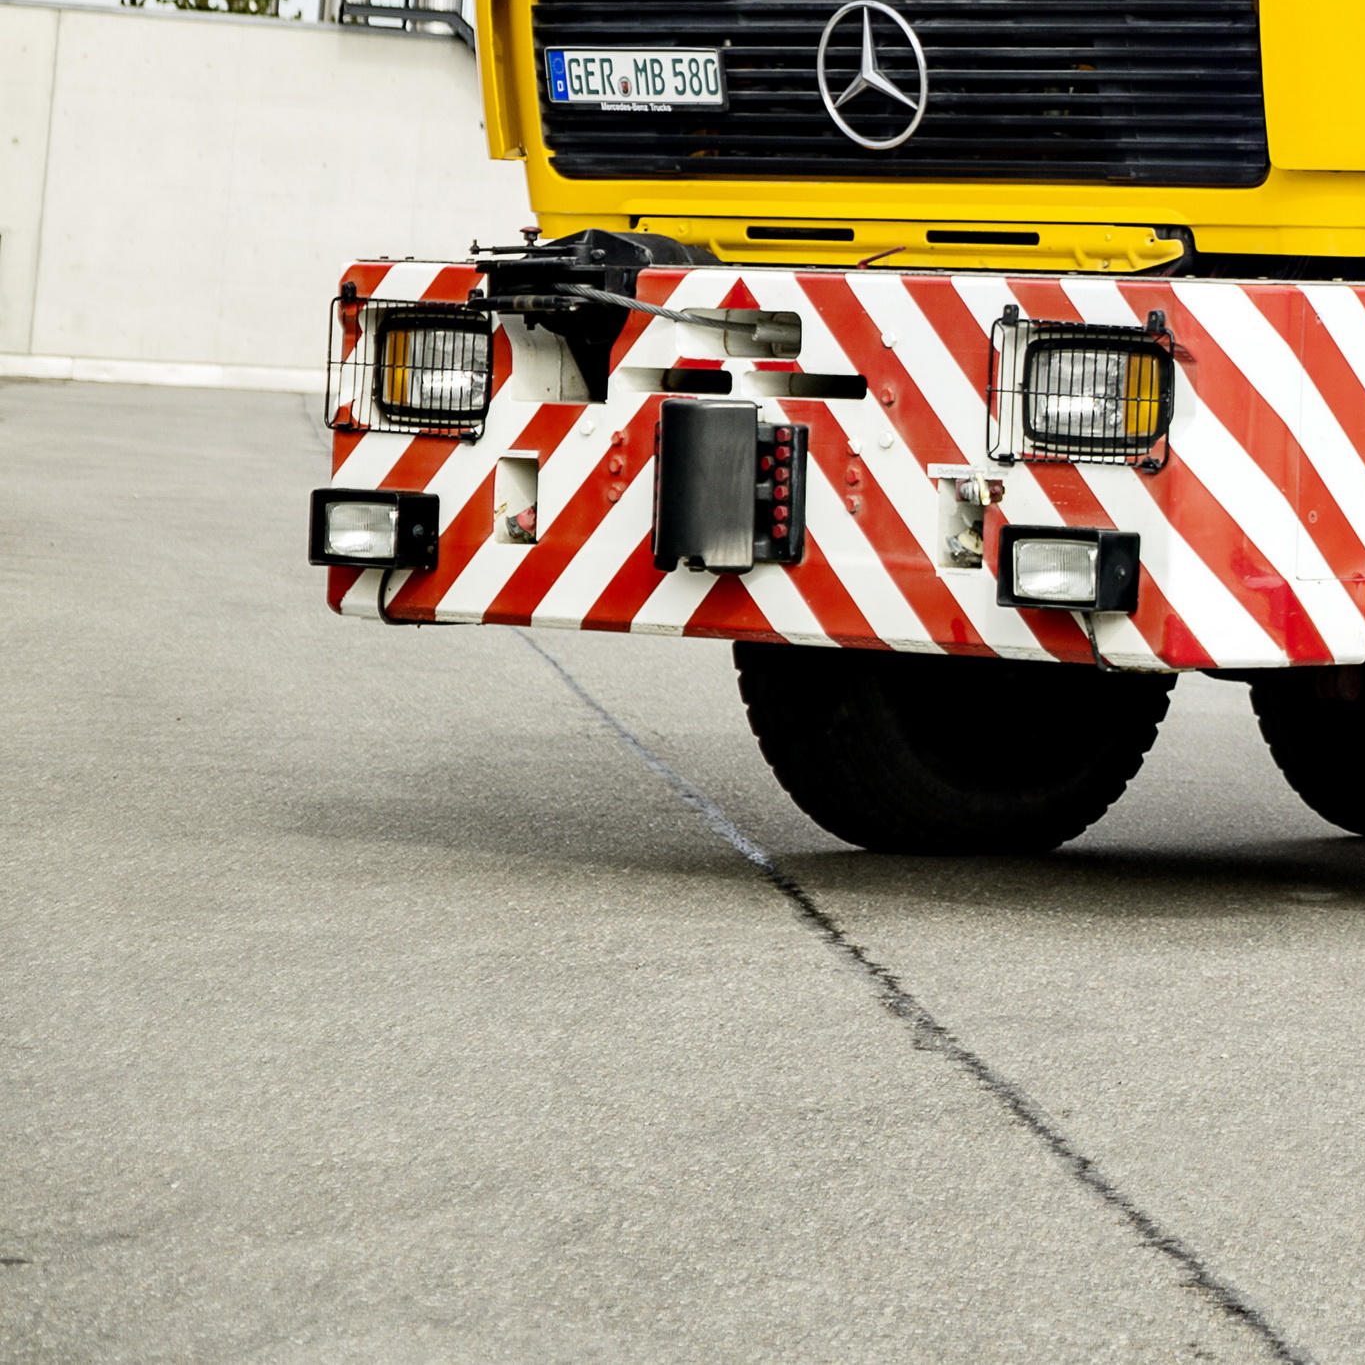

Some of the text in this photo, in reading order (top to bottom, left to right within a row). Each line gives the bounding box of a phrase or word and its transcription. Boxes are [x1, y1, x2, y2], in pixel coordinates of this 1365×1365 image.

[567, 57, 719, 97] GER MB 580
[557, 80, 564, 93] D
[600, 101, 673, 112] Mercedes-Benz Trucks
